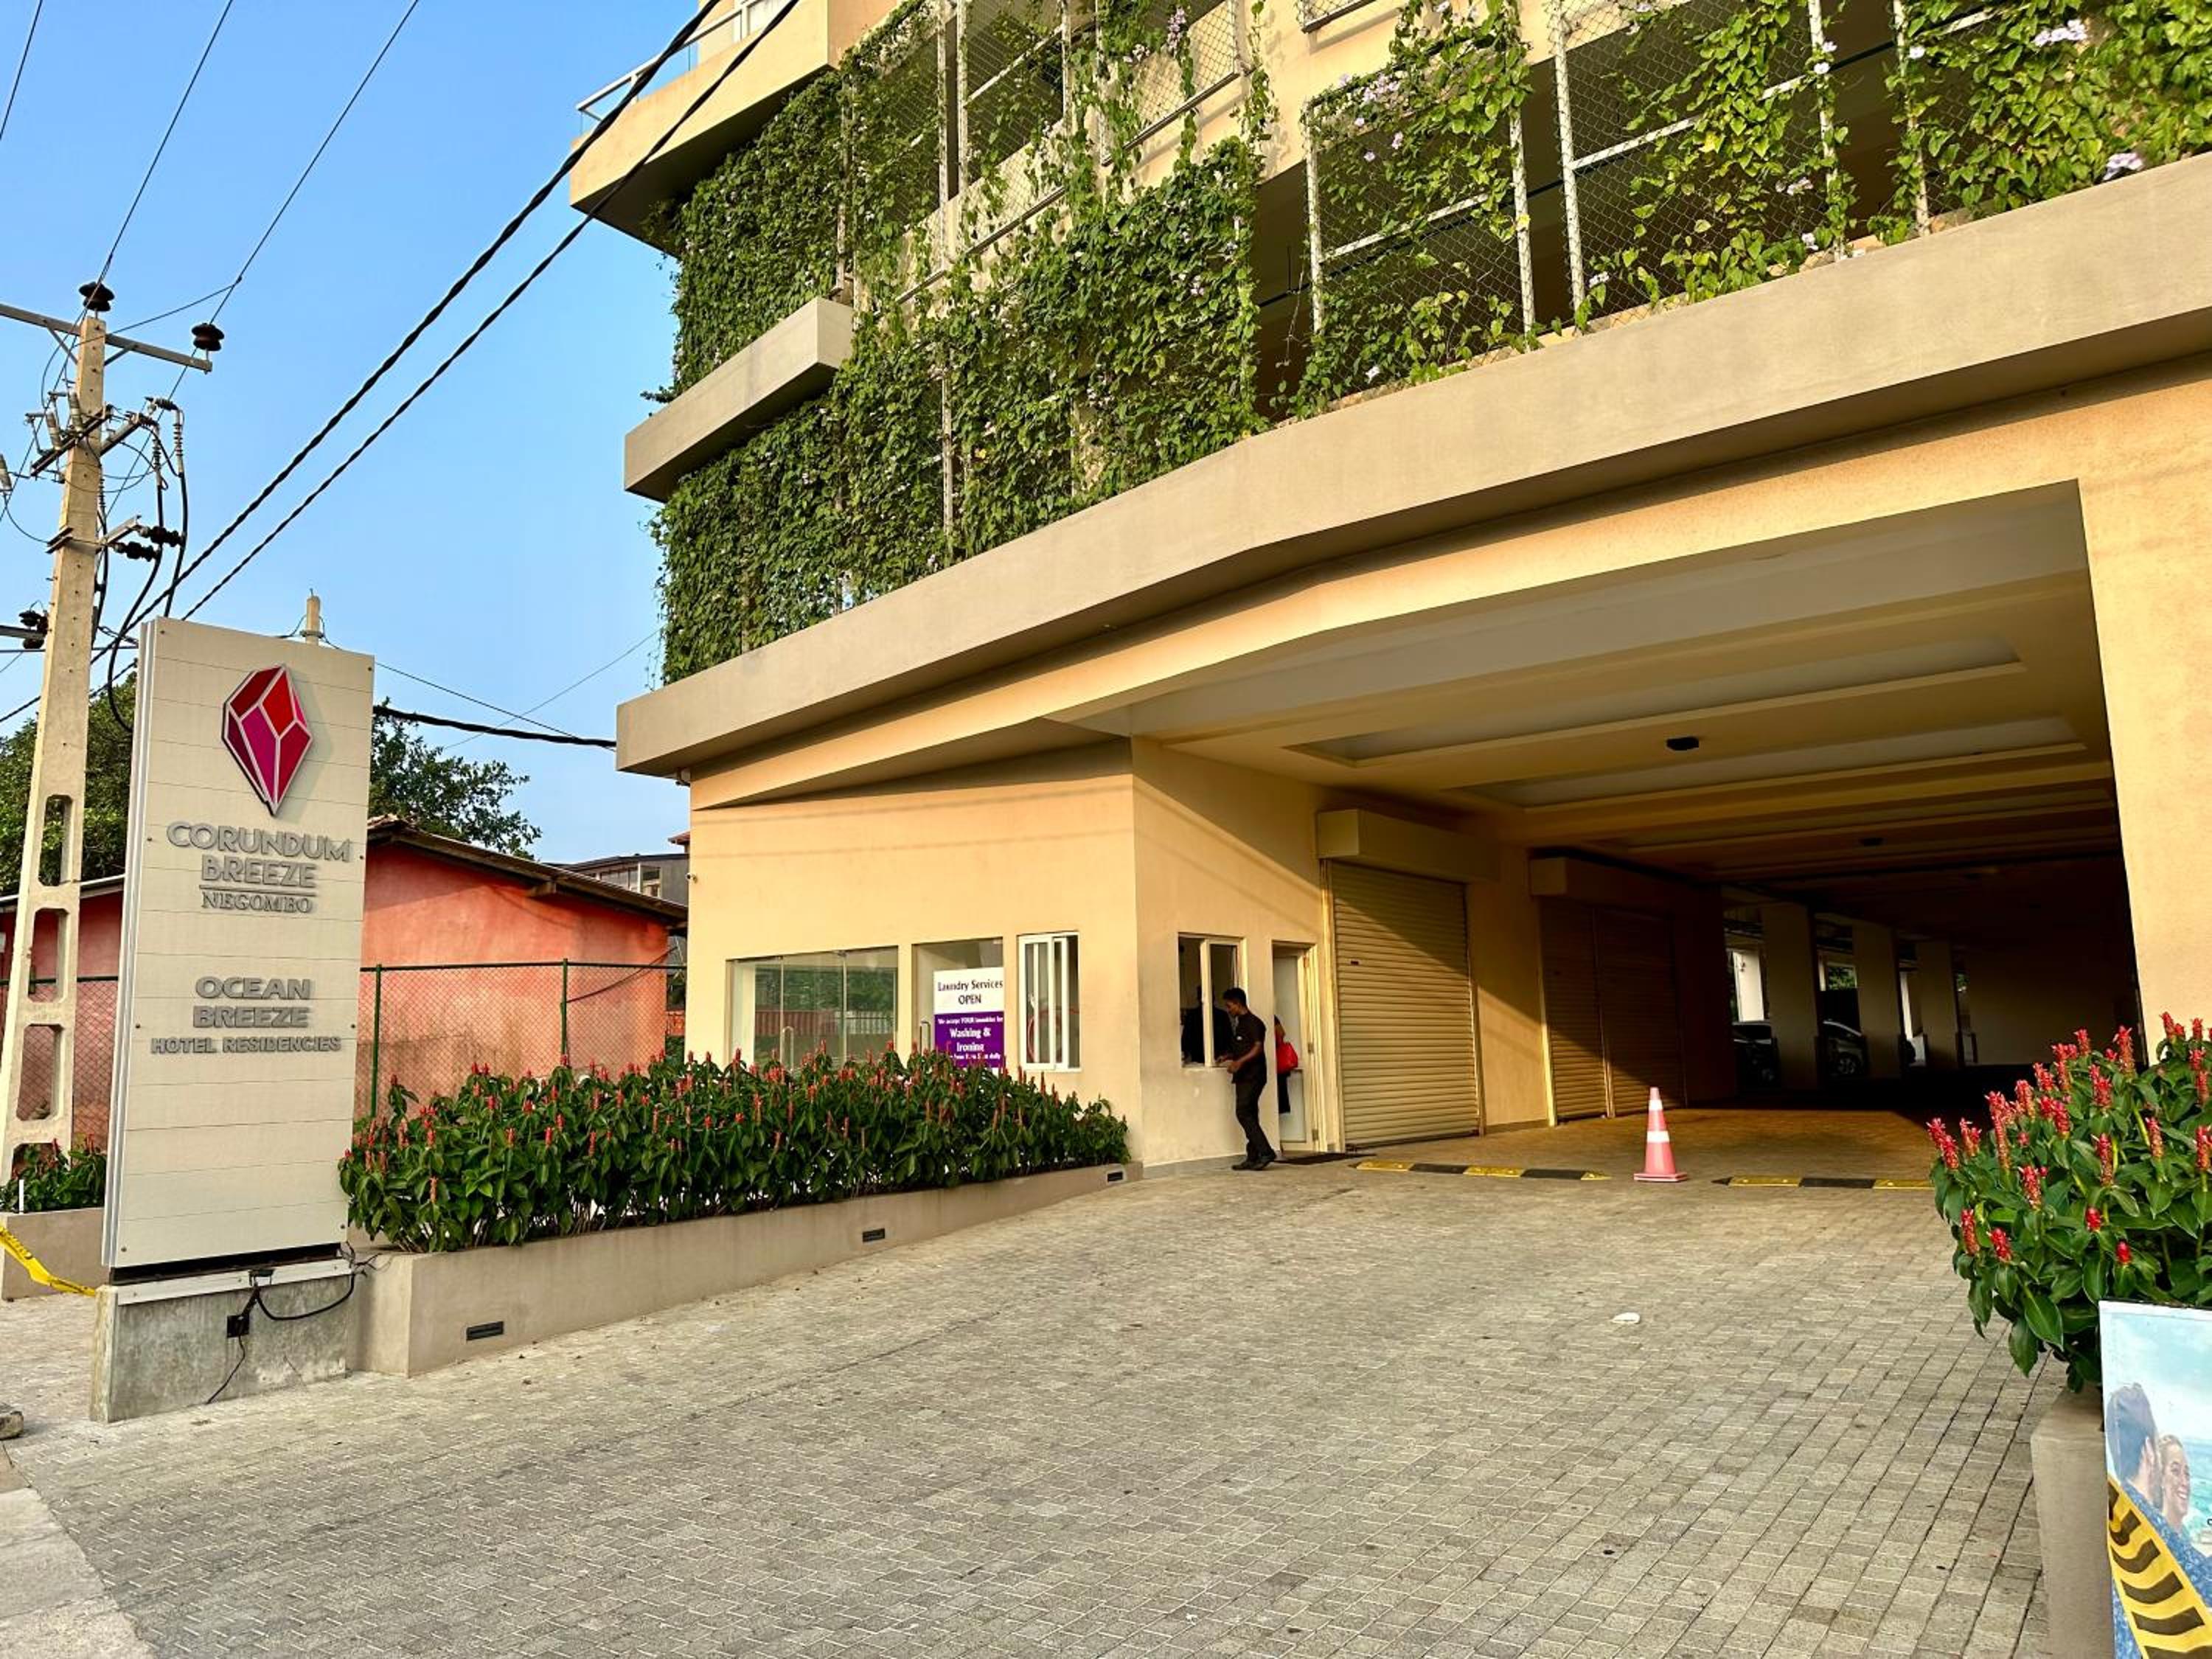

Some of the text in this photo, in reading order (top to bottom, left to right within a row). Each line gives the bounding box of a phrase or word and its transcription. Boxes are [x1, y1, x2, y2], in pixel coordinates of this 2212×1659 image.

[167, 821, 352, 862] CORUNDUM
[201, 855, 317, 888] BREEZE
[201, 891, 313, 913] NEGOMBO
[195, 976, 313, 1000] OCEAN
[937, 979, 1004, 991] Laundry Services
[959, 995, 981, 1004] OPEN
[192, 1006, 311, 1029] BREEZE
[949, 1027, 992, 1038] Washing &
[151, 1037, 341, 1054] HOTEL RESIDENCIES
[956, 1042, 984, 1052] Ironing
